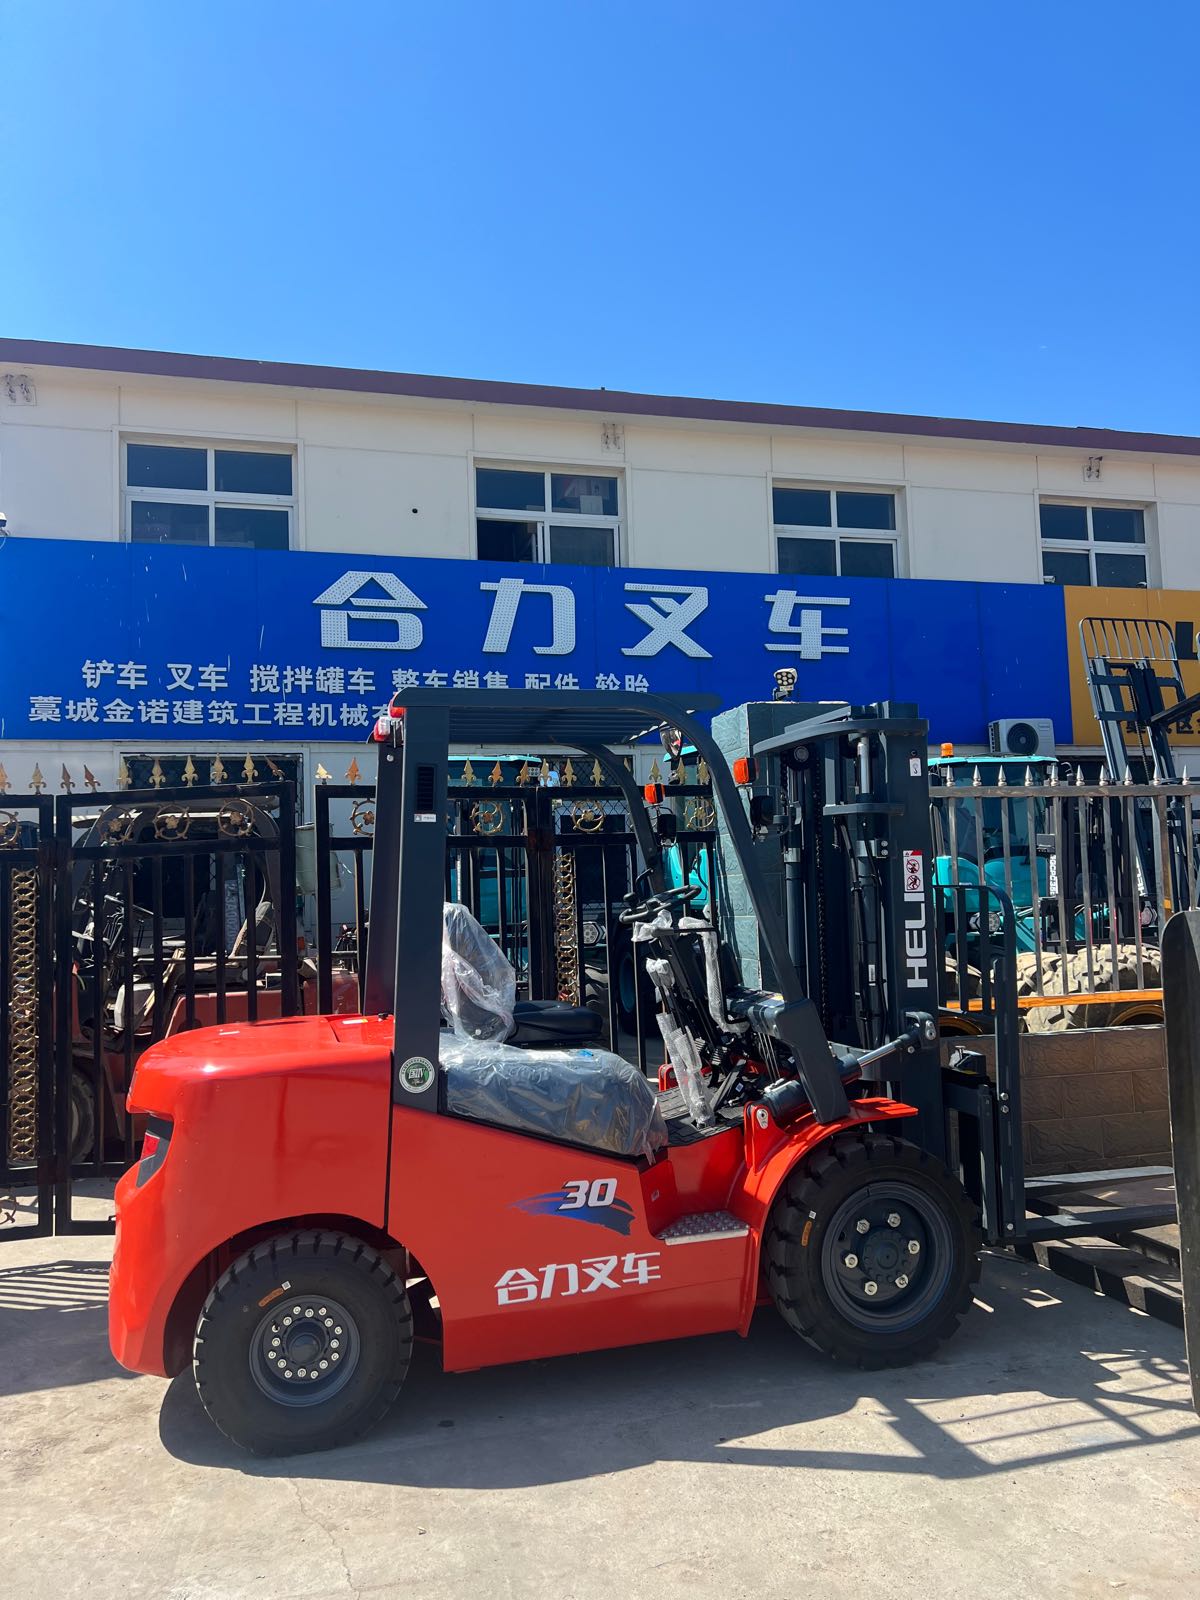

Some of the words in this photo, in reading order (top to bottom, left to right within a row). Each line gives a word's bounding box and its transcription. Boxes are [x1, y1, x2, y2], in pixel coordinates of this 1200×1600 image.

[313, 570, 851, 660] 合力叉车
[82, 660, 148, 691] 铲车
[166, 663, 229, 692] 叉车
[250, 664, 376, 695] 搅拌罐车
[904, 892, 929, 988] HELI
[558, 1178, 618, 1211] 30
[494, 1252, 661, 1306] 合力叉车
